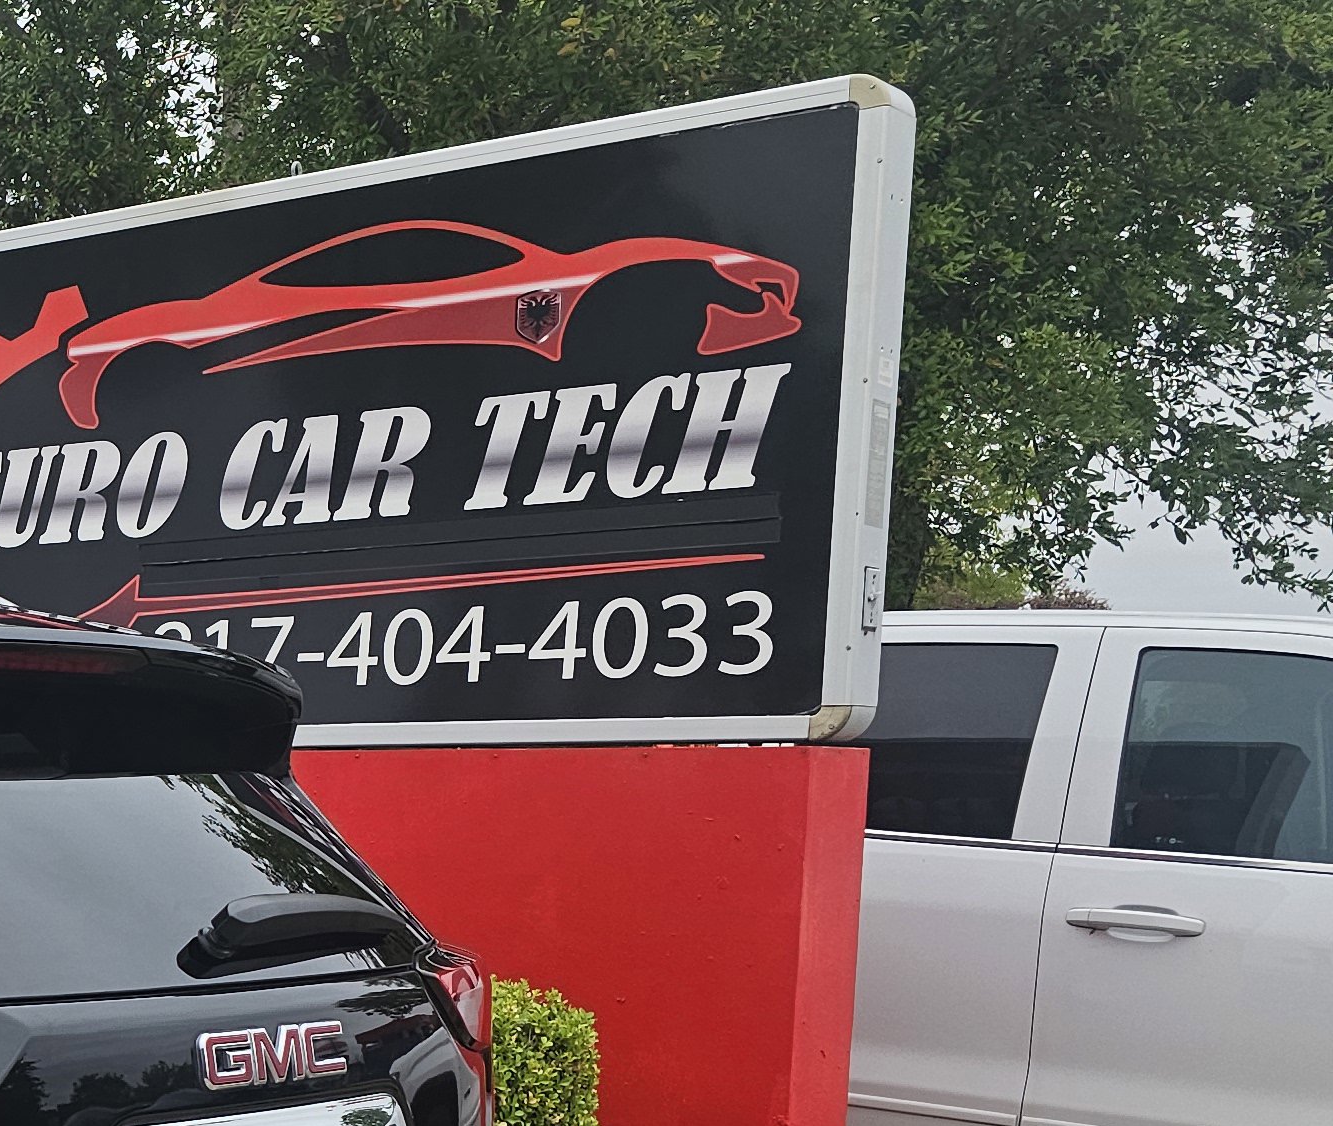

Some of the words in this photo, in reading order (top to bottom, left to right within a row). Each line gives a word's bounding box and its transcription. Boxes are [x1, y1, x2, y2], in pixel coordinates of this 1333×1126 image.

[219, 404, 432, 531] CAR
[463, 362, 792, 511] TECH
[154, 590, 775, 687] 7-404-4033
[196, 1020, 348, 1091] GMC
